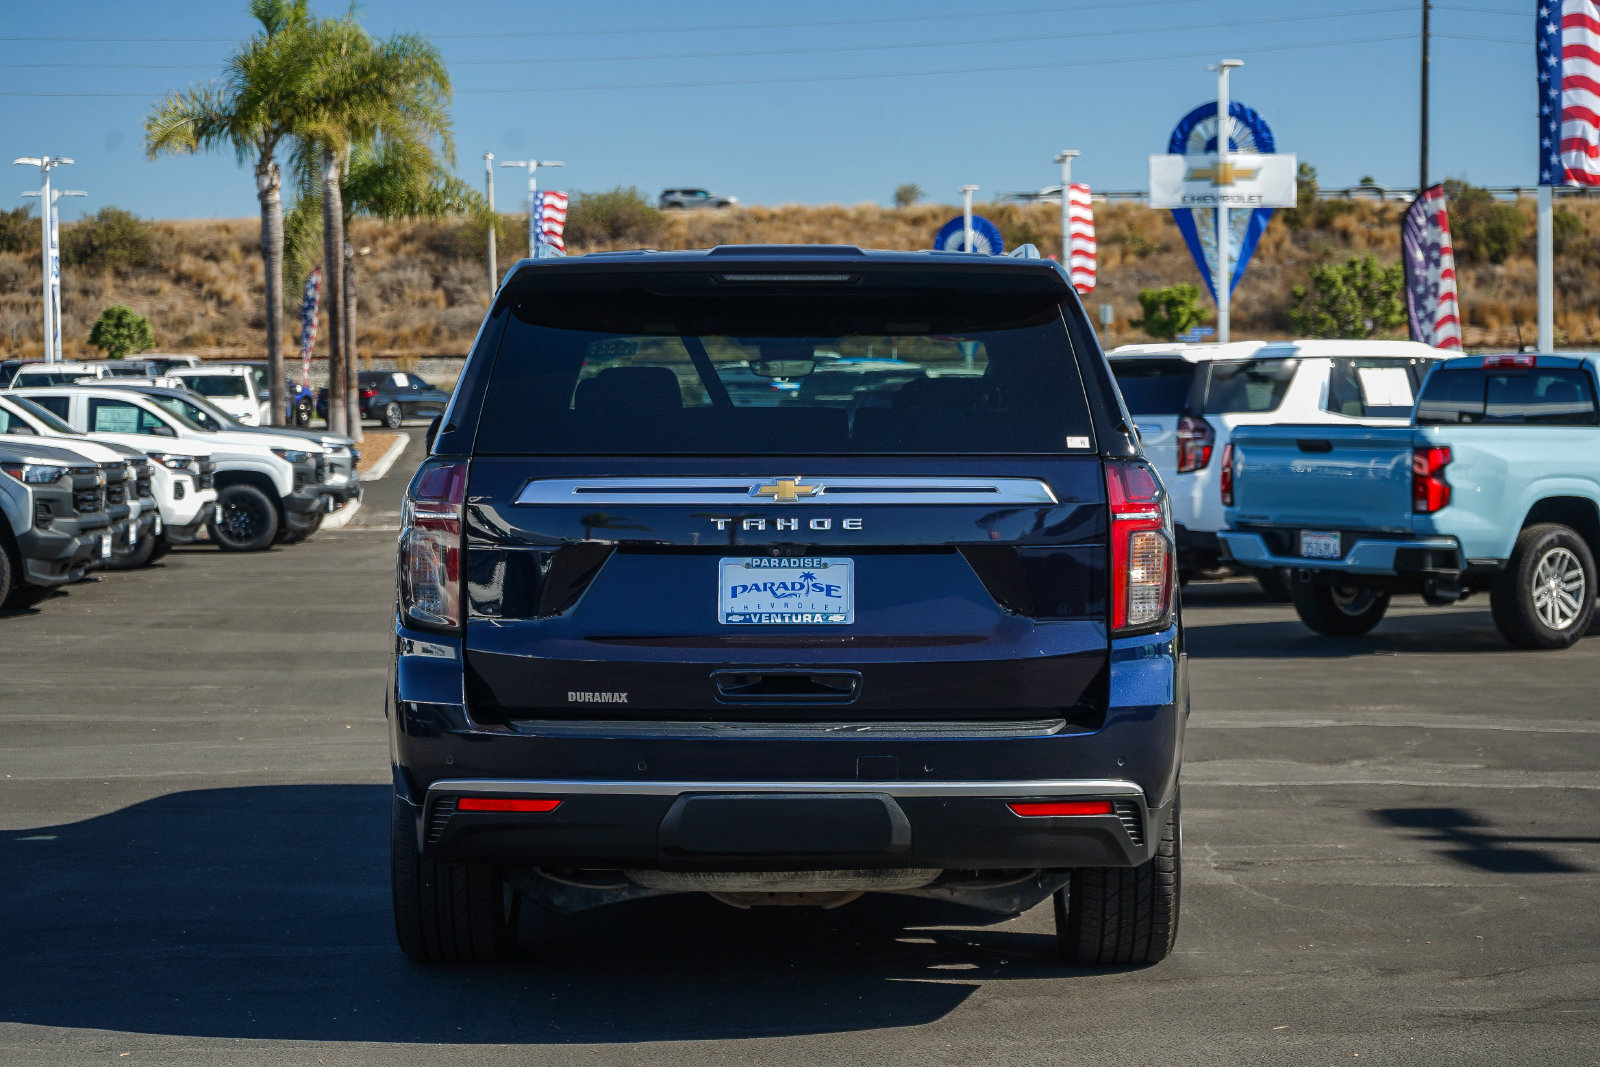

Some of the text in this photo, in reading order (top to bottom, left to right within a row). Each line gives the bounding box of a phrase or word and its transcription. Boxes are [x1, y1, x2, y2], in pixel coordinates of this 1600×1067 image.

[1181, 194, 1264, 204] CHEVROLET
[710, 517, 864, 531] TAHOE
[752, 558, 821, 568] PARADISE
[730, 571, 843, 599] PARADISE
[730, 602, 842, 613] CHEVROLET
[750, 613, 824, 623] VENTURA
[567, 691, 628, 704] DURAMAX
